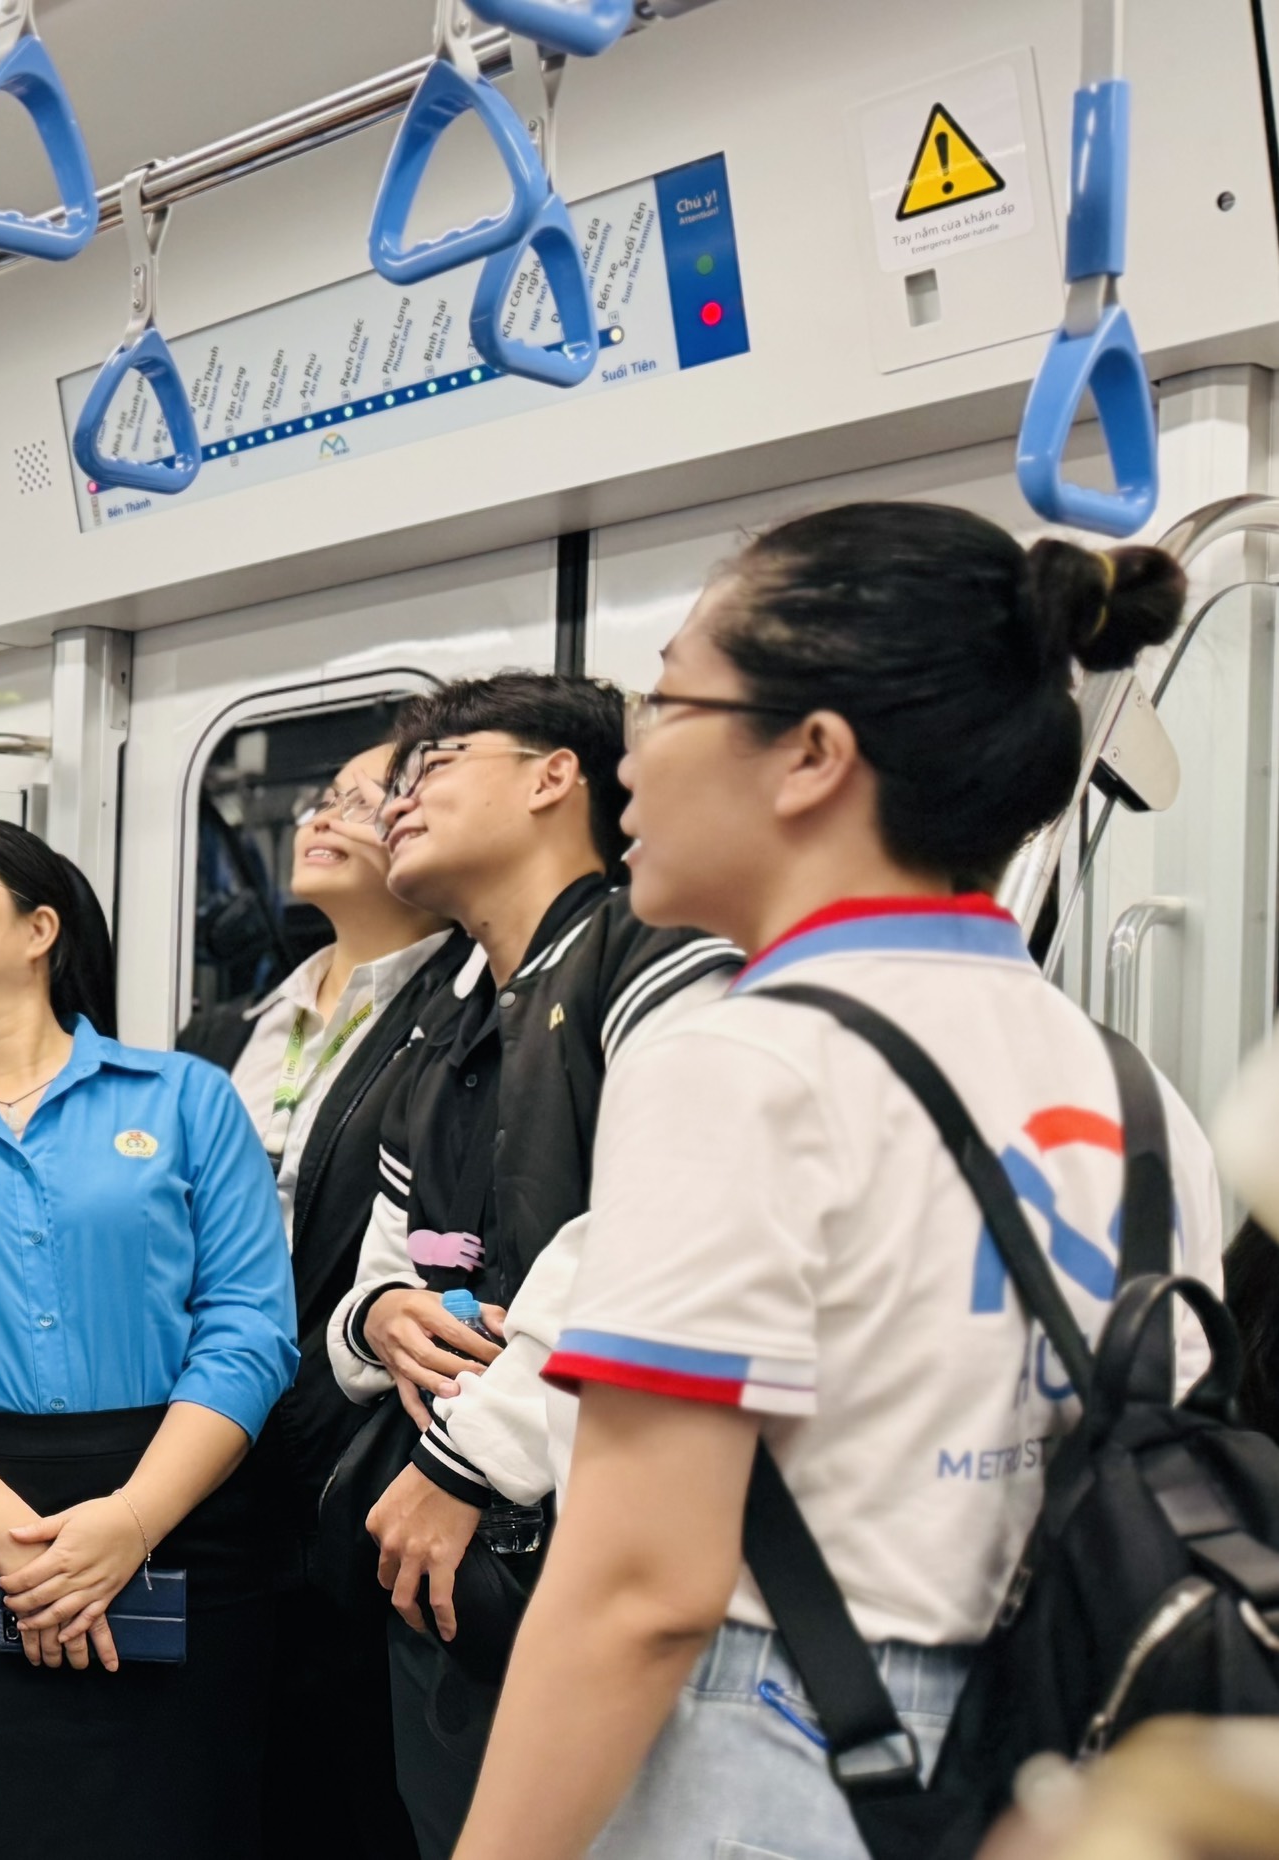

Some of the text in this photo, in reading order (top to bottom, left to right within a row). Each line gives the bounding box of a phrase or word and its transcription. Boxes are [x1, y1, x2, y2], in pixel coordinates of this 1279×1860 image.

[676, 194, 702, 213] Chú
[892, 235, 912, 246] Tay
[995, 202, 1016, 216] cấp
[588, 217, 600, 240] gia
[590, 222, 613, 273] University
[619, 202, 647, 268] Suối Tiên
[636, 209, 655, 254] Terminal
[911, 239, 951, 254] Emergency
[502, 272, 529, 338] Khu Công
[529, 283, 548, 331] High Tech
[596, 262, 618, 310] Bến xe
[382, 332, 400, 374] Phước
[393, 297, 411, 330] Long
[423, 332, 439, 361] Bình
[432, 299, 447, 327] Thái
[299, 380, 310, 399] An
[601, 359, 657, 383] Suối Tiên
[225, 401, 237, 421] Tân
[107, 505, 124, 518] Bến
[124, 498, 152, 512] Thành
